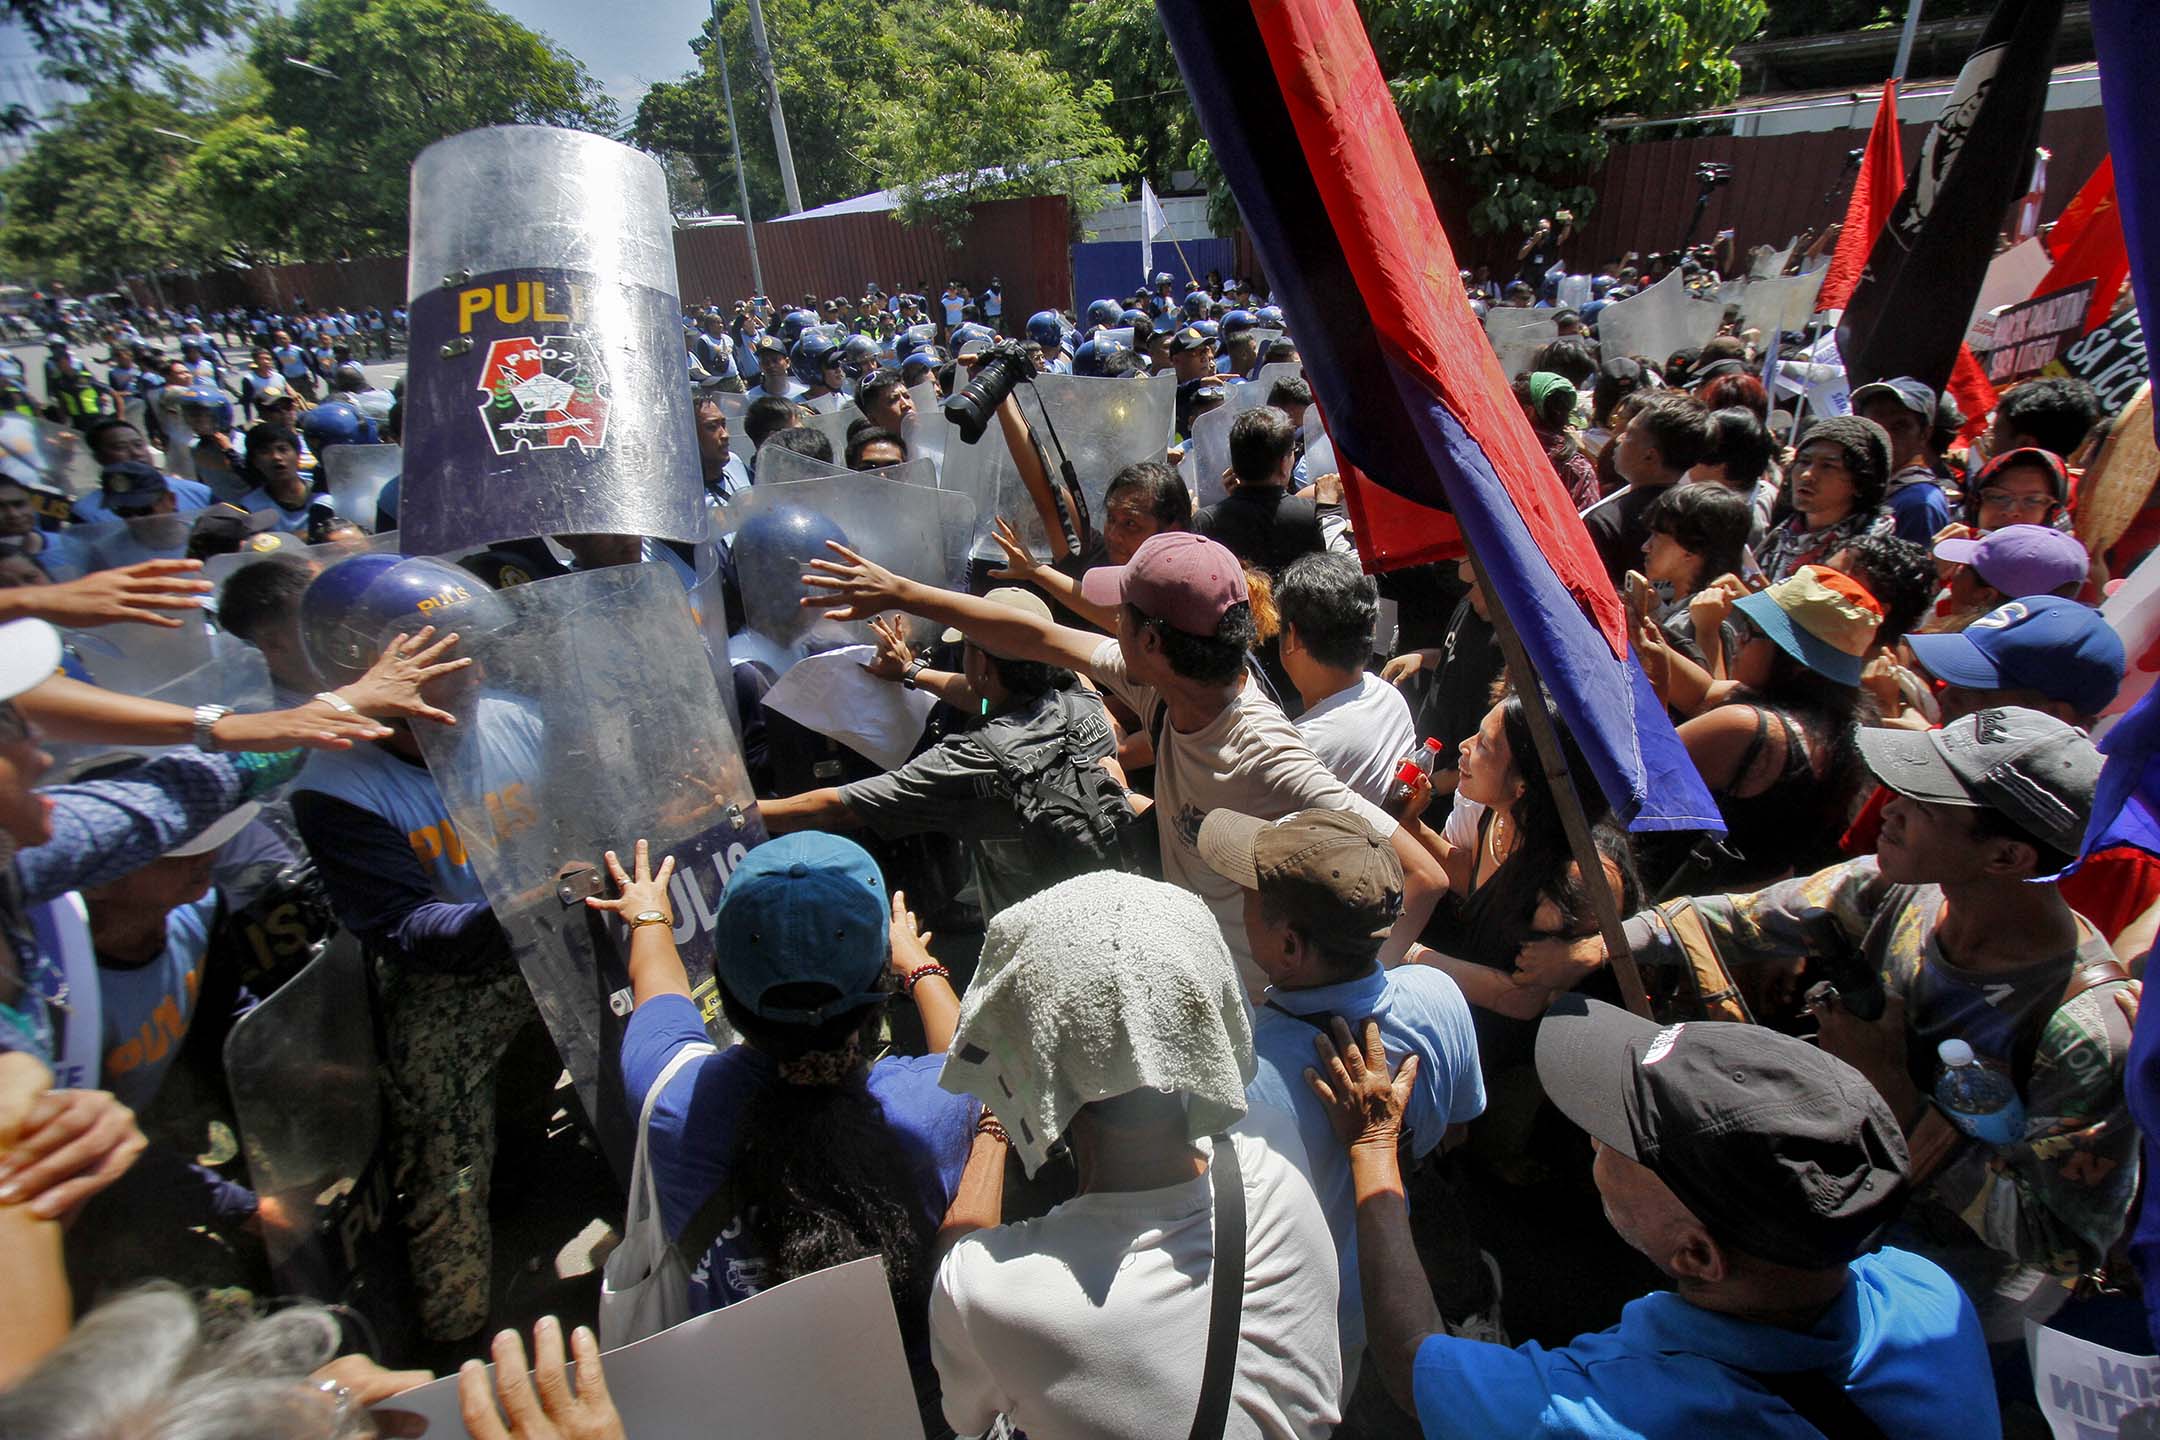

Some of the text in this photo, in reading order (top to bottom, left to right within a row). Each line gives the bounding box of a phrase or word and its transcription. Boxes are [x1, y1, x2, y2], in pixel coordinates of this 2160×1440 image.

[459, 281, 585, 335] PULI
[505, 349, 575, 367] PRO2
[416, 585, 473, 617] PULIS
[408, 783, 537, 874] PUIS
[622, 842, 750, 945] ULIS
